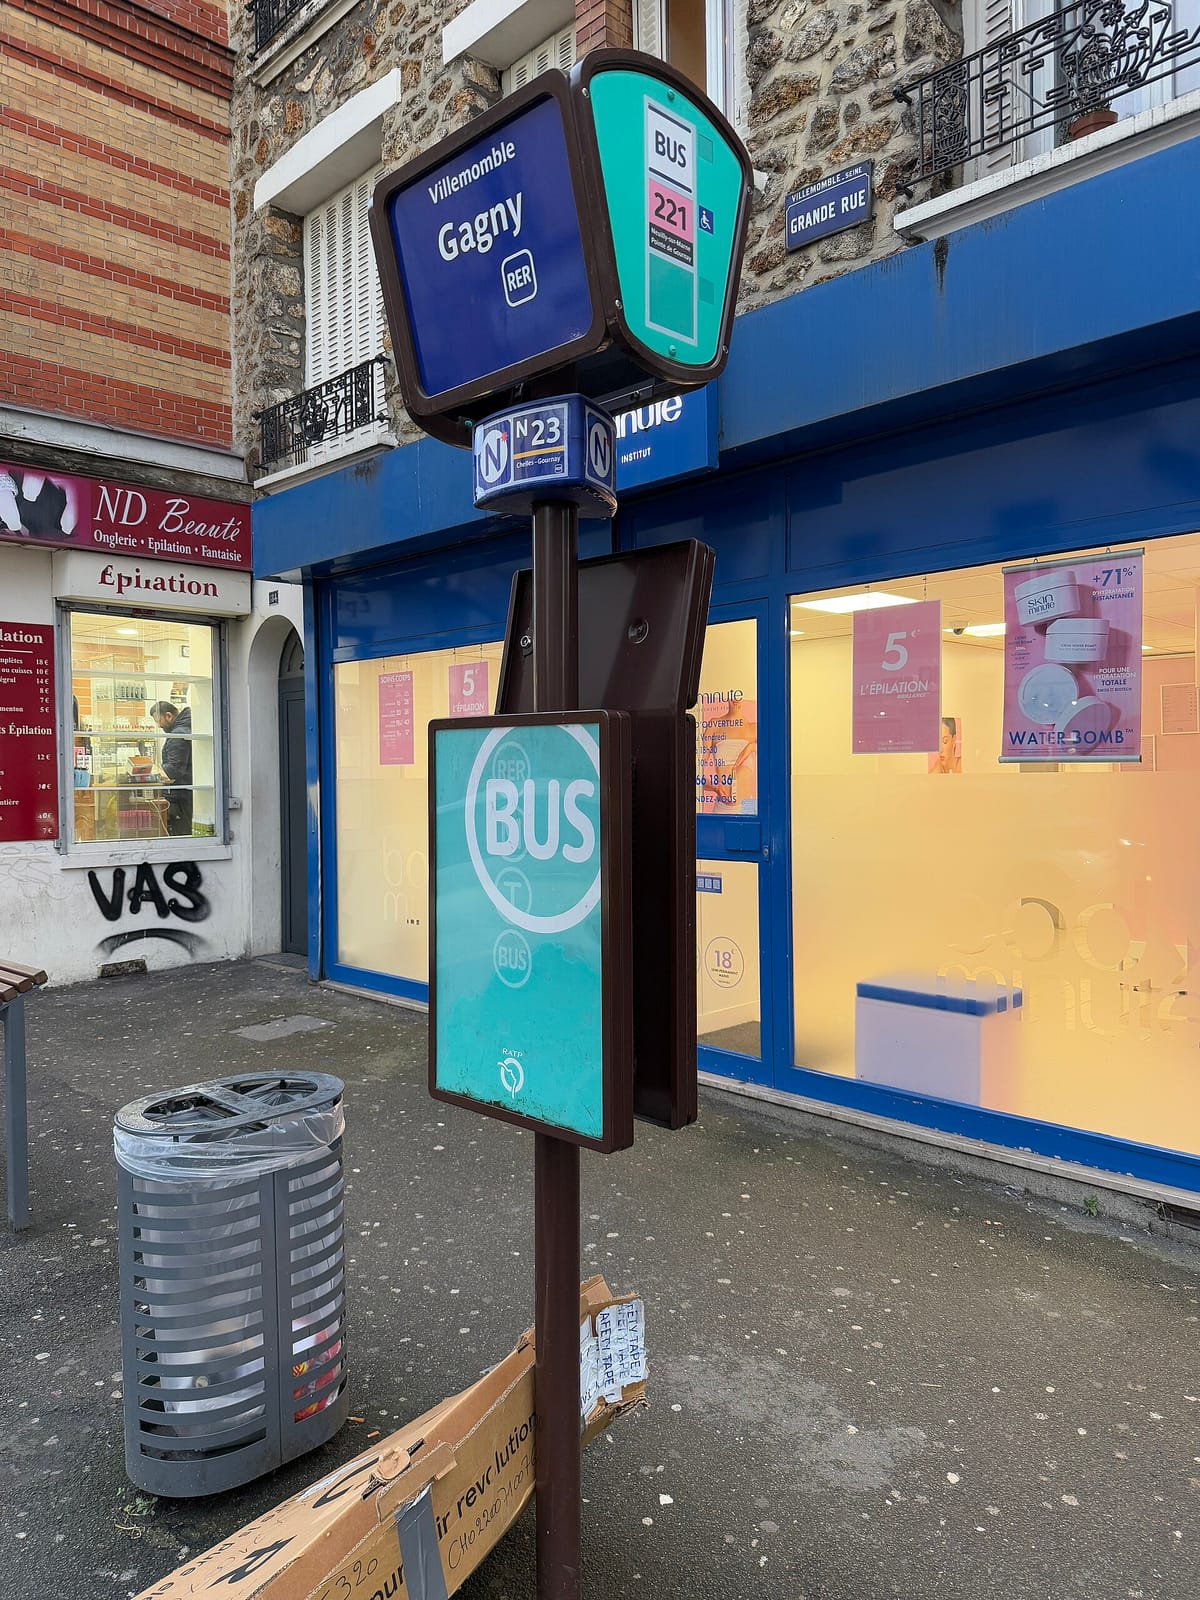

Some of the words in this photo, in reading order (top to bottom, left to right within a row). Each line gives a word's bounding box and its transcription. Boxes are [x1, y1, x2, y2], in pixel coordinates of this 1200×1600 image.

[655, 129, 687, 169] BUS
[428, 141, 516, 204] Villemomble
[438, 191, 522, 262] Gagny
[654, 192, 686, 232] 221
[790, 201, 836, 234] GRANDE
[841, 189, 866, 214] RUE
[673, 247, 692, 263] Gournay
[506, 264, 532, 292] RER
[616, 395, 683, 439] inute
[621, 447, 651, 464] INSTITUT
[93, 485, 147, 526] ND
[158, 498, 242, 542] Beauté
[93, 528, 137, 548] Onglerie
[148, 537, 192, 556] Epilation
[201, 545, 242, 562] Fantaisie
[1028, 601, 1055, 616] minute
[11, 667, 33, 675] cuisses
[1101, 678, 1127, 686] TOTALE
[860, 679, 929, 696] L'ÉPILATION
[9, 722, 53, 737] Épilation
[1008, 731, 1066, 745] WATER
[709, 774, 719, 786] 18
[721, 774, 733, 786] 36
[486, 778, 595, 864] BUS
[88, 861, 212, 923] VAS
[498, 946, 527, 971] BUS
[502, 1047, 523, 1058] RATP
[629, 1335, 641, 1370] TAPE
[602, 1353, 615, 1389] TAPE
